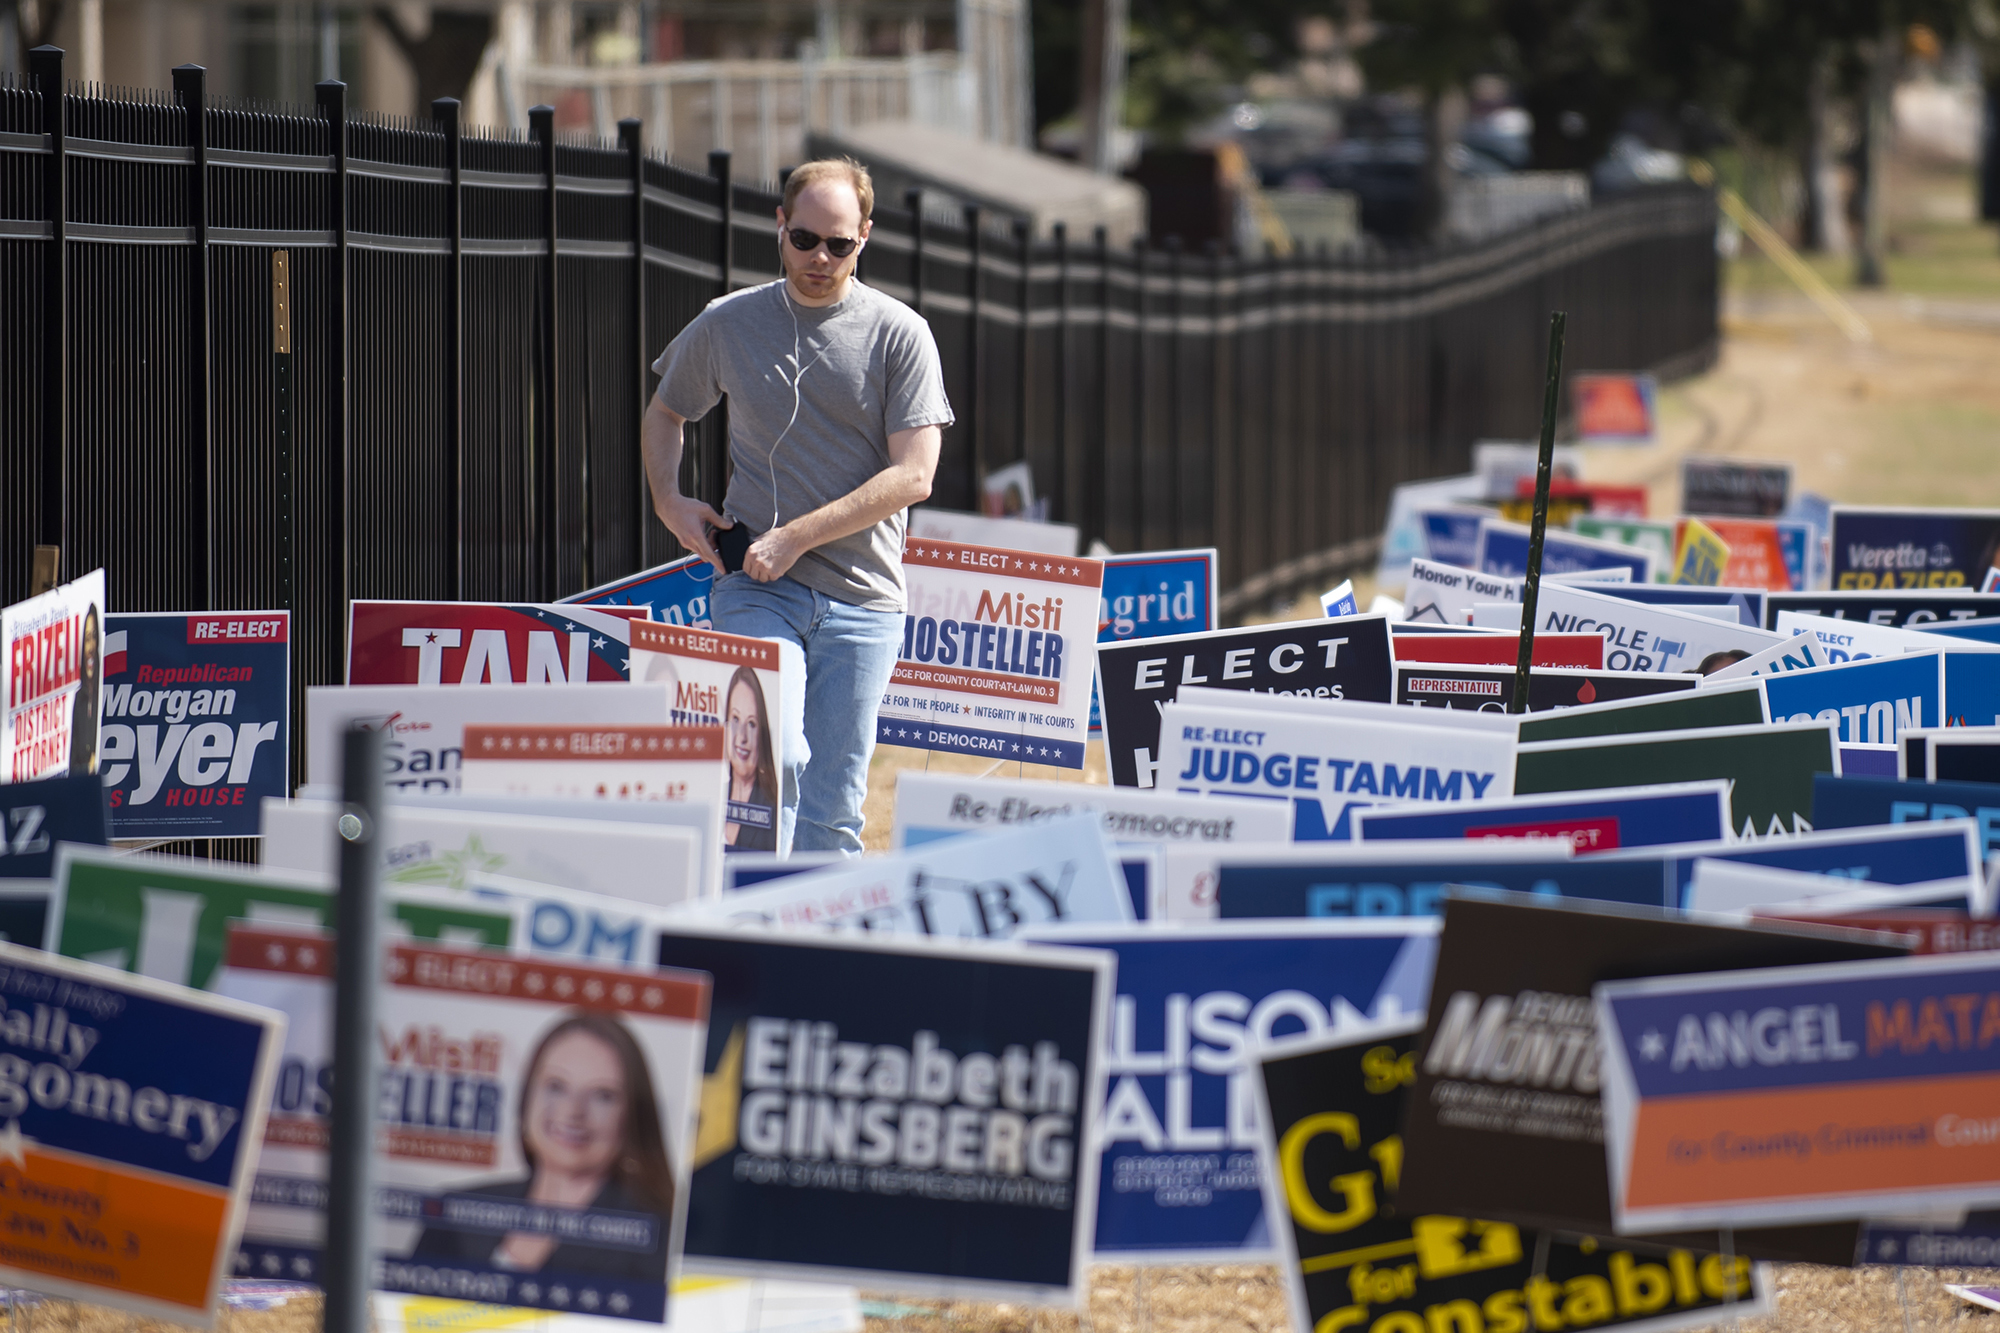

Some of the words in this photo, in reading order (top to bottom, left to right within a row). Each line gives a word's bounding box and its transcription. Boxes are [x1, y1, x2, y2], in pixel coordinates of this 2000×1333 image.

[960, 550, 1009, 569] ELECT
[1847, 543, 1927, 568] Veretta
[1412, 560, 1462, 590] Honor
[1465, 575, 1502, 598] Your
[975, 589, 1064, 631] Misti
[194, 620, 281, 639] RE-ELECT
[687, 634, 719, 654] ELECT
[1545, 610, 1648, 651] NICOLE
[11, 613, 82, 709] FRIZELL
[137, 663, 253, 687] Republican
[1134, 637, 1349, 690] ELECT
[676, 680, 718, 714] Misti
[914, 670, 932, 682] FOR
[933, 673, 969, 686] COUNTY
[1033, 687, 1048, 697] NO.
[1048, 688, 1055, 697] 3
[1410, 678, 1499, 694] REPRESENTATIVE
[15, 695, 67, 747] DISTRICT
[101, 683, 237, 724] Morgan
[893, 695, 910, 708] FOR
[912, 697, 928, 710] THE
[930, 700, 960, 714] PEOPLE
[974, 706, 1016, 721] INTEGRITY
[1018, 711, 1027, 722] IN
[1029, 713, 1043, 725] THE
[1045, 715, 1075, 729] COURTS
[569, 732, 627, 755] ELECT
[928, 731, 1006, 752] DEMOCRAT
[1182, 725, 1266, 747] RE-ELECT
[11, 728, 69, 784] ATTORNEY
[1180, 747, 1321, 790] JUDGE
[1328, 759, 1495, 802] TAMMY
[165, 787, 246, 806] HOUSE
[749, 809, 770, 825] COURTS
[949, 792, 1073, 823] Re-Ele
[1099, 810, 1235, 839] emocrat
[1670, 1003, 1858, 1074] ANGEL
[743, 1015, 1081, 1115] Elizabeth
[739, 1089, 1075, 1181] GINSBERG
[1346, 1261, 1418, 1305] for
